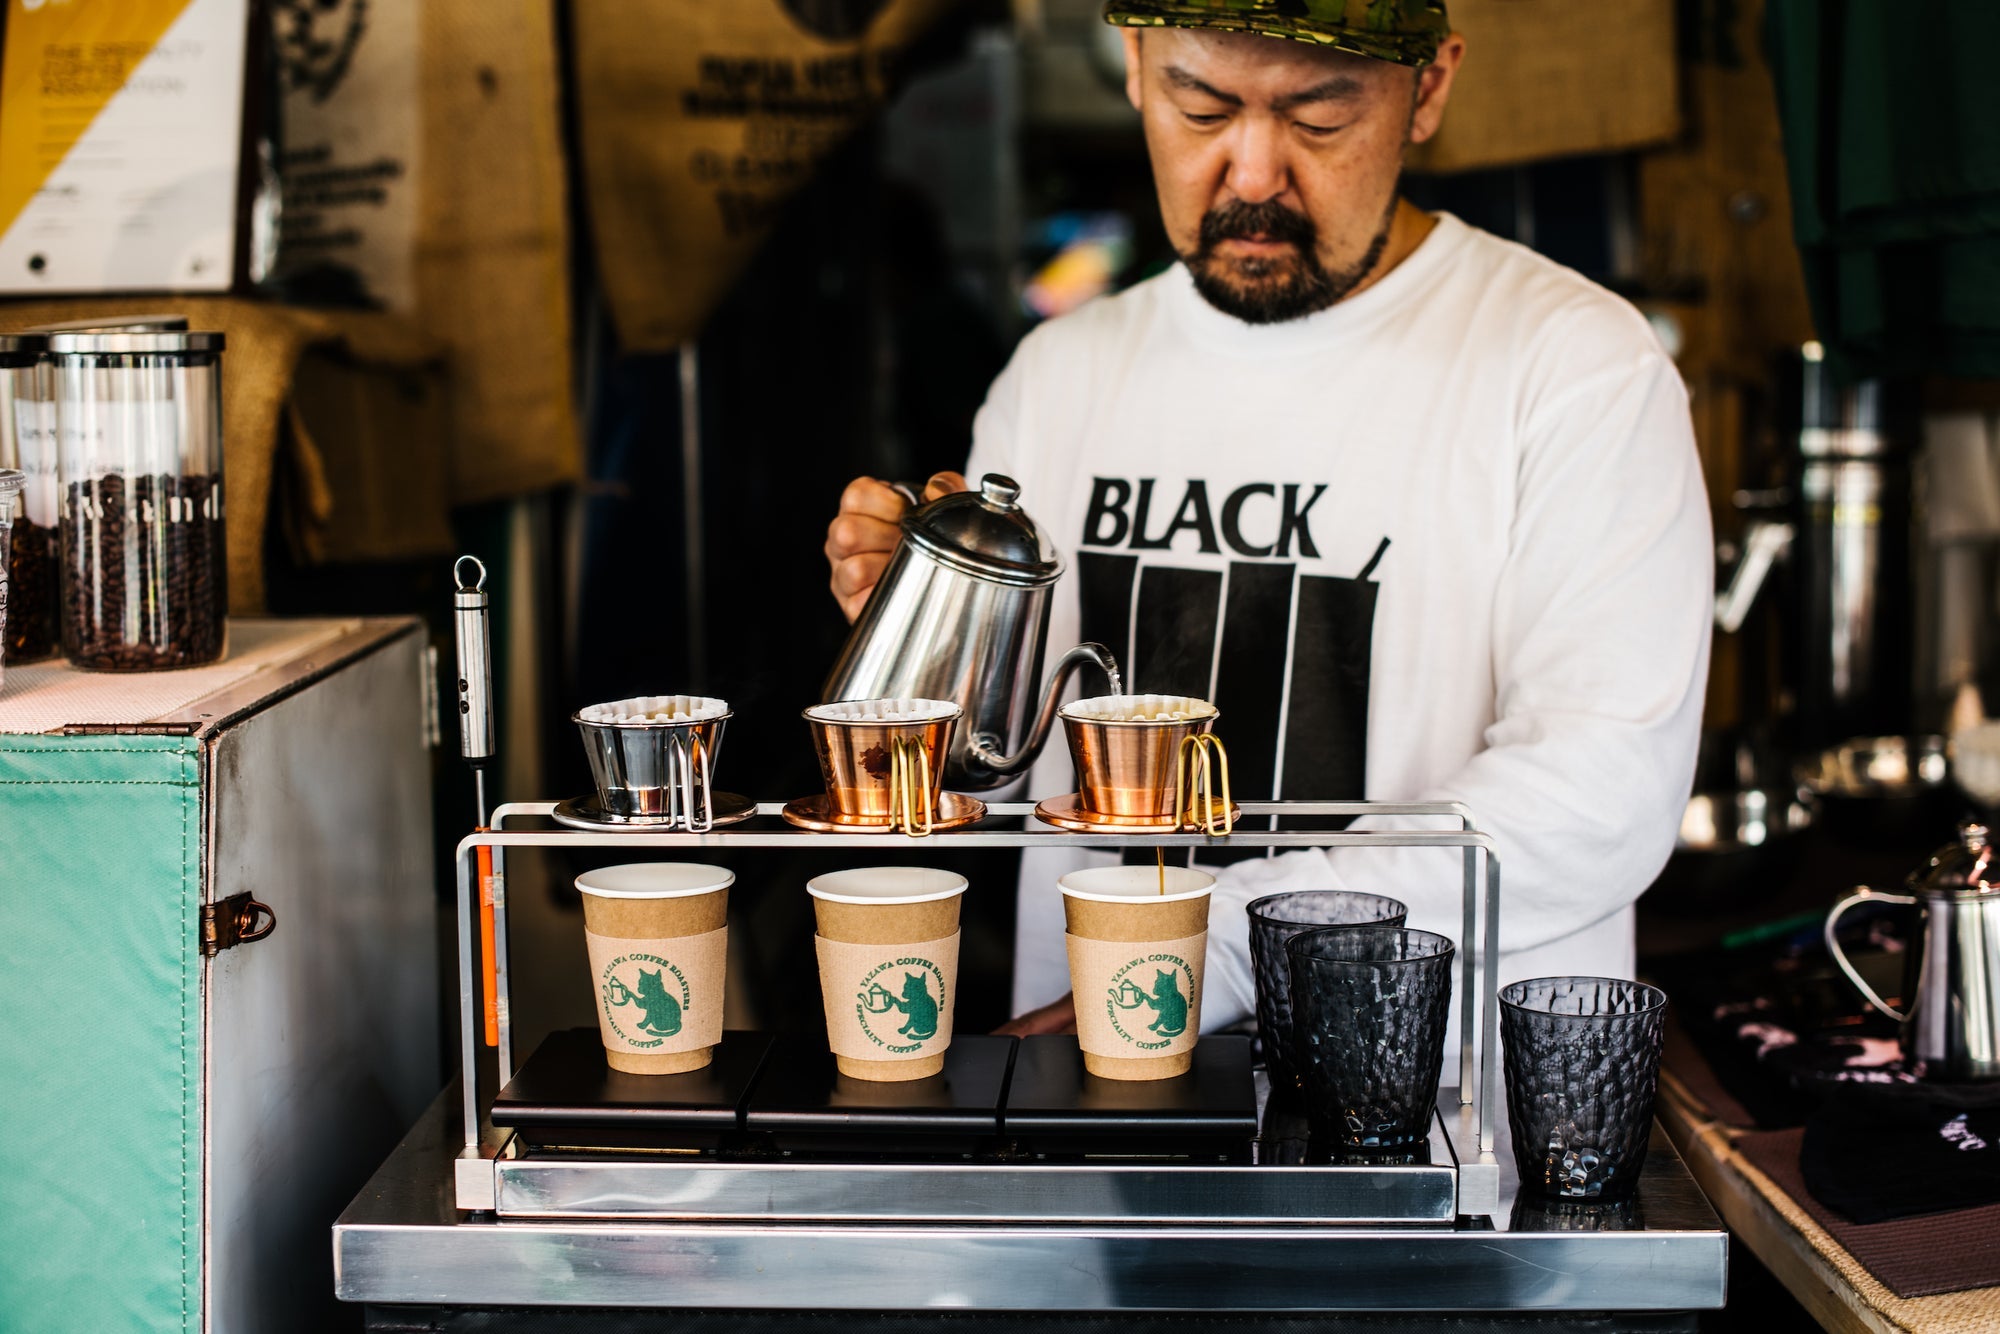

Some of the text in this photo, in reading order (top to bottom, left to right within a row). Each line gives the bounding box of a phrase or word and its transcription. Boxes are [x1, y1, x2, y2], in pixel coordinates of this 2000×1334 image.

[1082, 477, 1328, 559] BLACK
[603, 953, 690, 1011] YAZAWA COFFEE ROASTERS
[860, 961, 894, 988] YAZAWA
[896, 957, 934, 970] COFFEE
[1111, 957, 1145, 984] YAZAWA
[1148, 954, 1184, 967] COFFEE
[628, 1038, 664, 1049] COFFEE
[856, 1003, 923, 1053] SPECIALTY COFFEE
[1106, 999, 1172, 1050] SPECIALTY COFFEE
